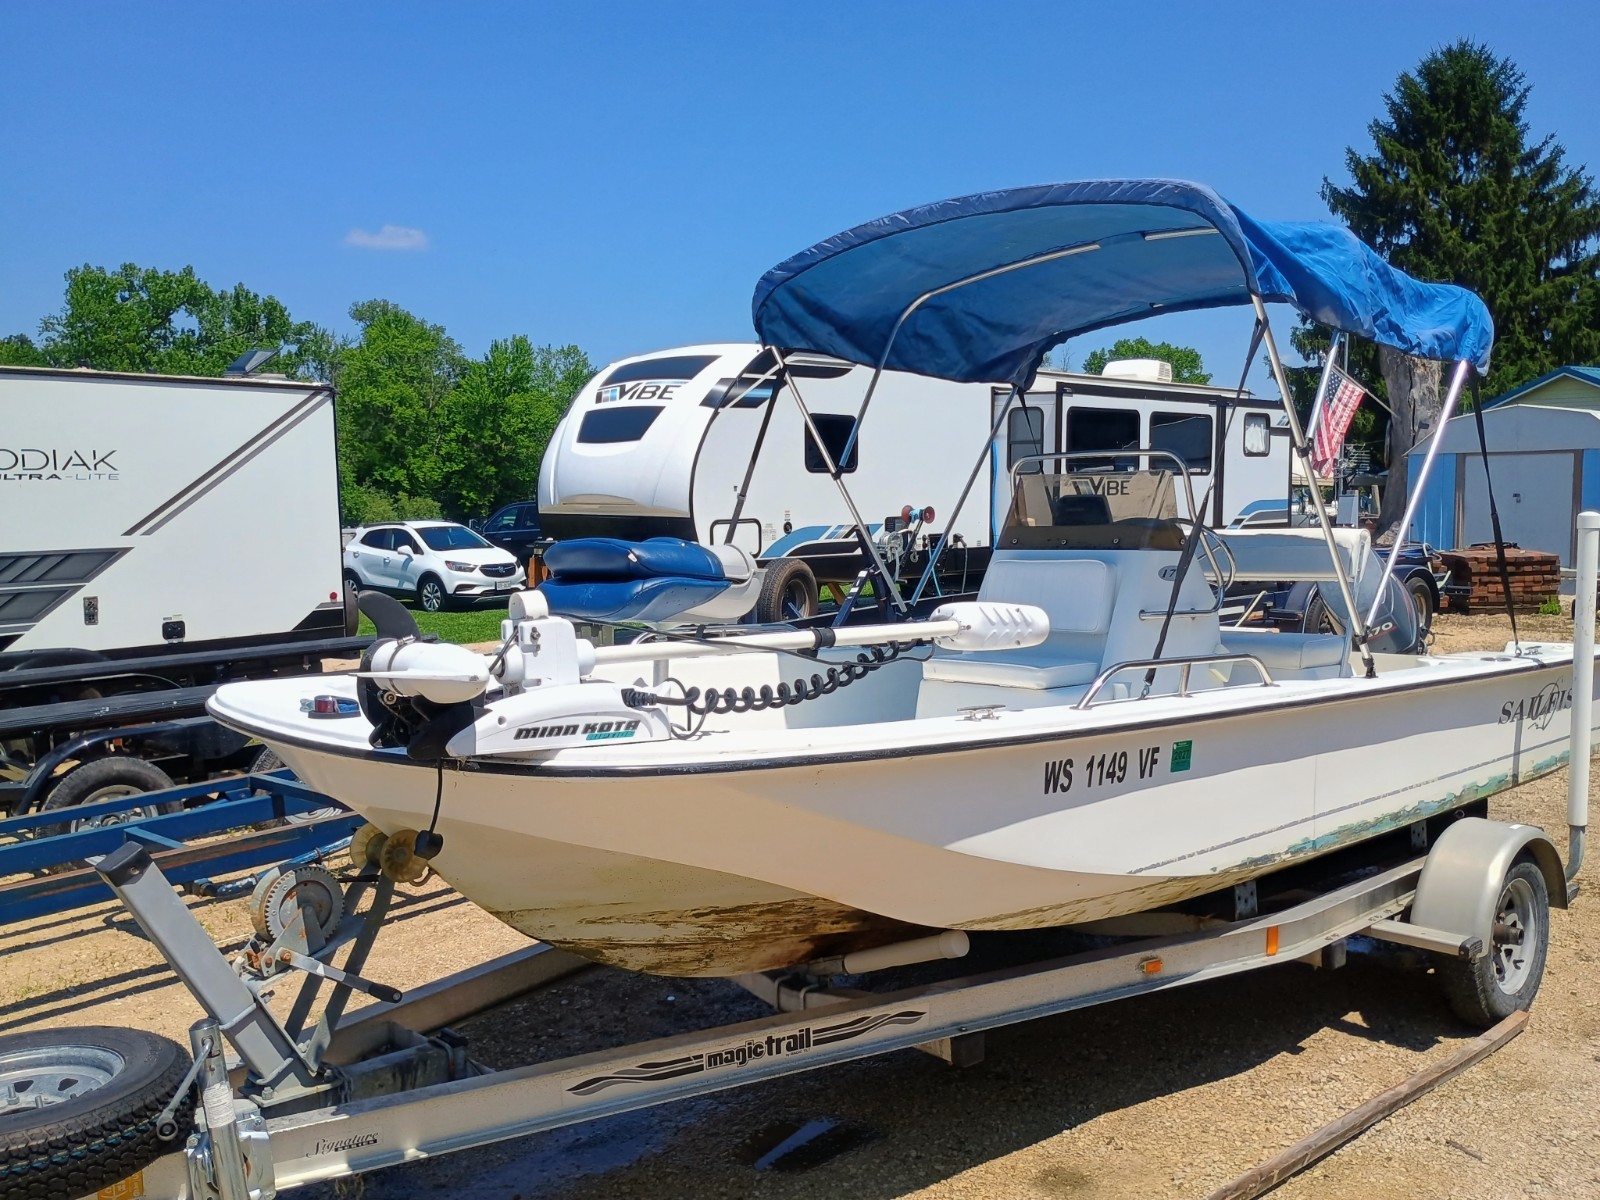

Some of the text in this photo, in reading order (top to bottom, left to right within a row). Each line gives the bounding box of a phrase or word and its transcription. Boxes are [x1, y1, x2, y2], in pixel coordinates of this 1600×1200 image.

[618, 382, 682, 401] VIBE
[0, 449, 119, 471] ODIAK
[1368, 622, 1393, 638] 70
[1498, 687, 1573, 725] SAILFIS
[581, 720, 641, 735] KOTA
[1044, 746, 1160, 794] WS 1149 VF
[305, 1132, 379, 1158] Signature
